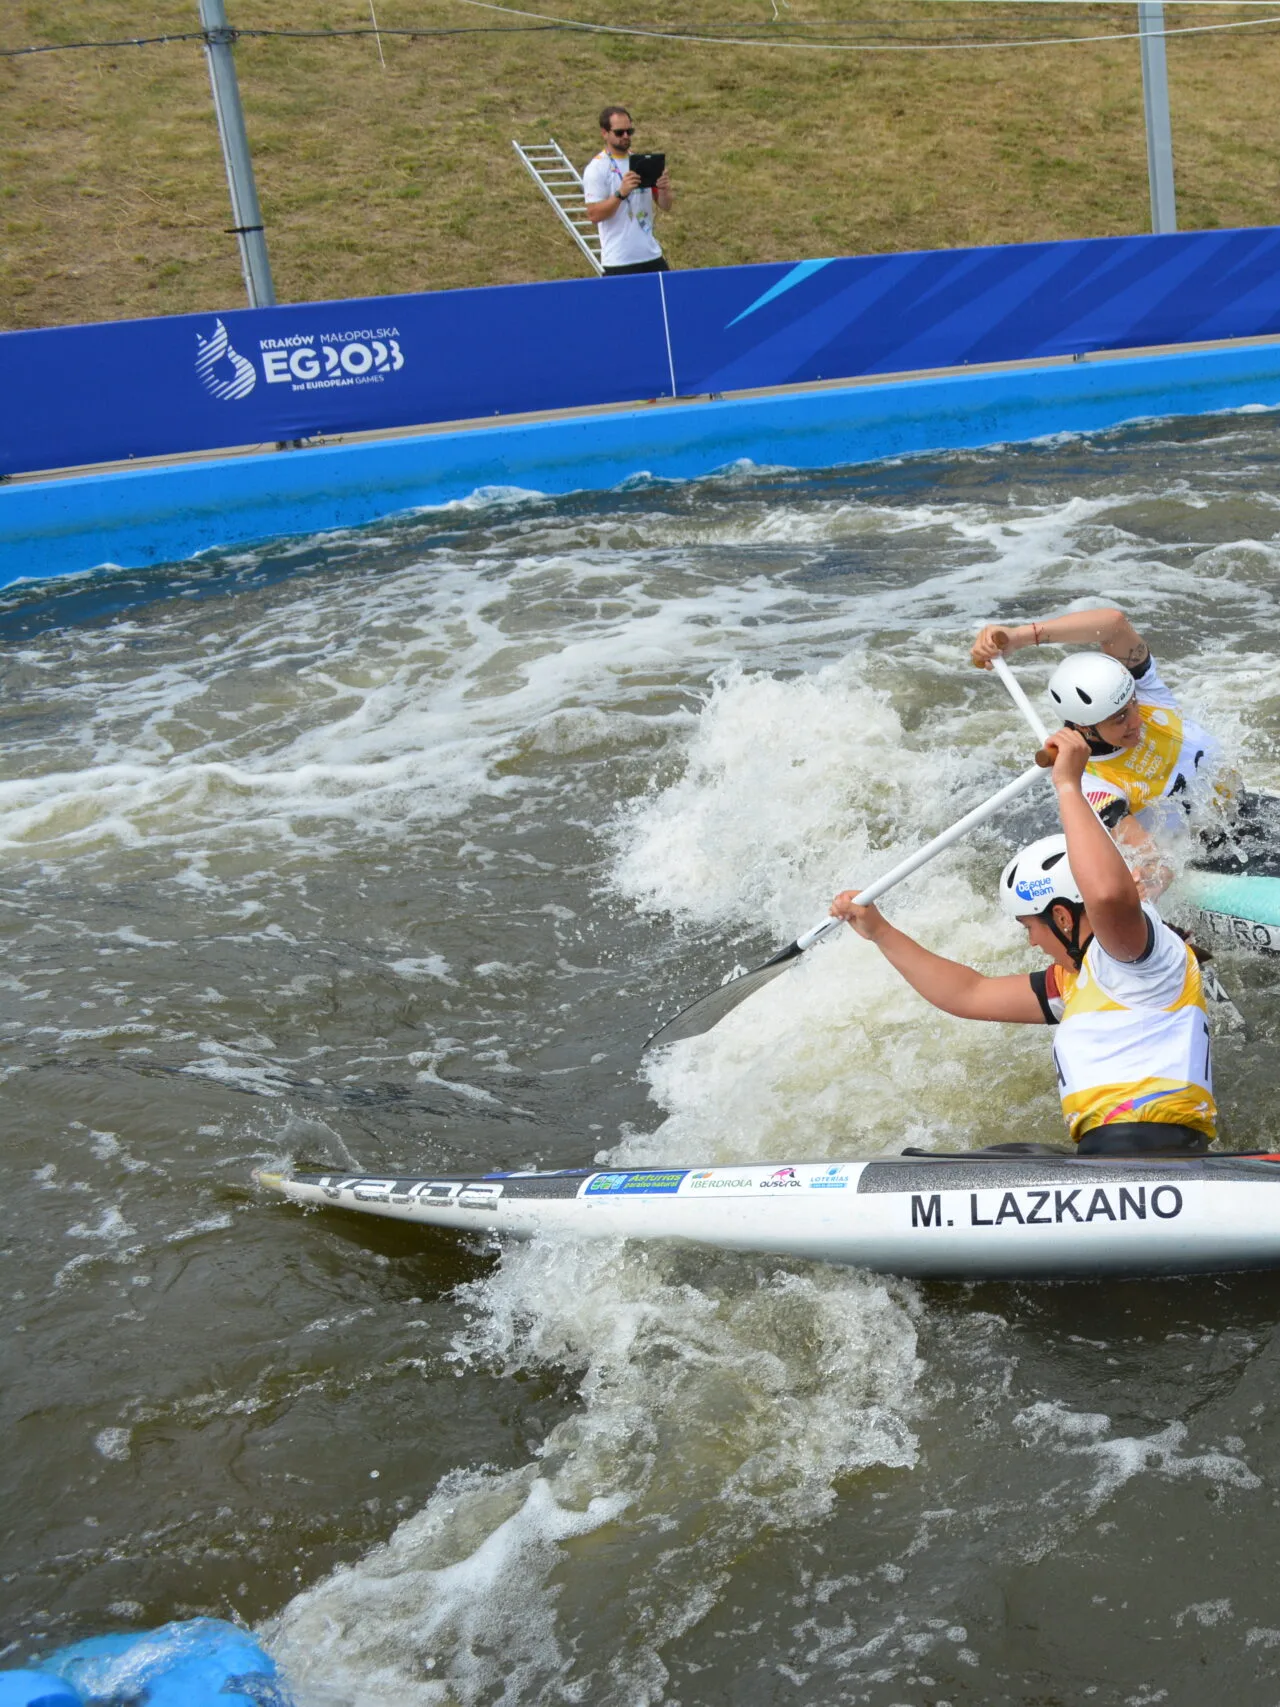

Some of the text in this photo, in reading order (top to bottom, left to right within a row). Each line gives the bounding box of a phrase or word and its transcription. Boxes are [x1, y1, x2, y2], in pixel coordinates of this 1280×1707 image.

[259, 327, 400, 350] KRAKÓW MAŁOPOLSKA
[261, 340, 404, 384] EG2023
[306, 378, 354, 390] EUROPEAN
[355, 374, 385, 385] GAMES
[1018, 877, 1052, 892] basque
[1030, 885, 1055, 898] team
[629, 1173, 684, 1182] Asturias
[652, 1180, 679, 1188] natural
[690, 1179, 753, 1189] IBERDROLA
[911, 1184, 1184, 1228] M. LAZKANO
